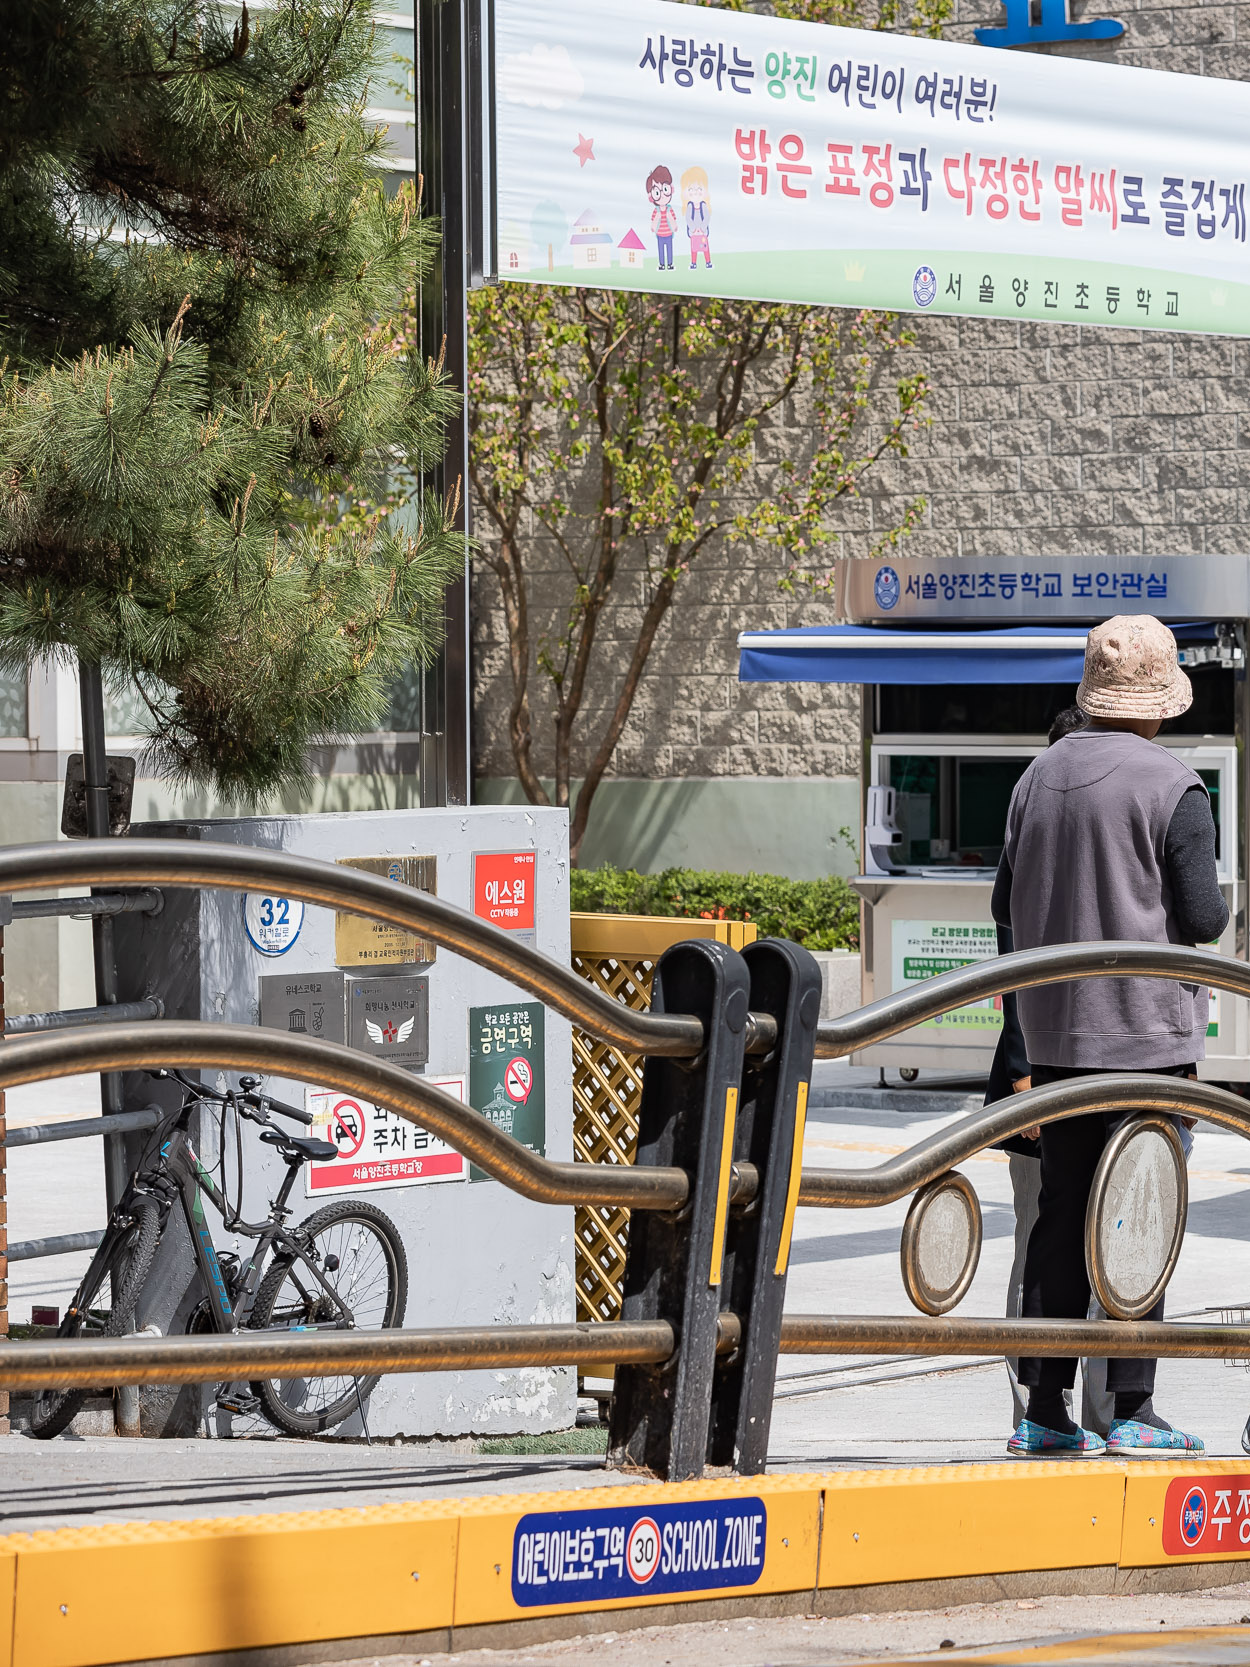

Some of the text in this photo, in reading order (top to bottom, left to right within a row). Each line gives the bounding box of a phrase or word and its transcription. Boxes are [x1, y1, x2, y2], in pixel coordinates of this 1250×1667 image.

[639, 35, 997, 124] 사랑하는 양진 어린이 여러분!
[735, 128, 812, 199] 밝은
[825, 143, 932, 212] 표정과
[943, 152, 1043, 222] 다정한
[1054, 163, 1150, 231] 말씨로
[1160, 177, 1247, 243] 즐겁게
[945, 273, 1179, 317] 서울양진초등학교
[905, 571, 1168, 600] 서울양진초등학교 보안관실
[485, 879, 526, 905] 에스원
[260, 898, 290, 926] 32
[490, 907, 519, 918] CCTV 작동중
[259, 927, 289, 939] 워커힐로
[286, 984, 322, 996] 유네스코학교
[485, 1011, 530, 1026] 학교 모든 공간은
[480, 1024, 532, 1054] 금연구역
[373, 1126, 407, 1154] 주차
[352, 1159, 423, 1180] 서울양진초등학교장
[199, 1230, 232, 1315] LESPO
[517, 1515, 763, 1585] 어린이보호구역 30 SCHOOL ZONE
